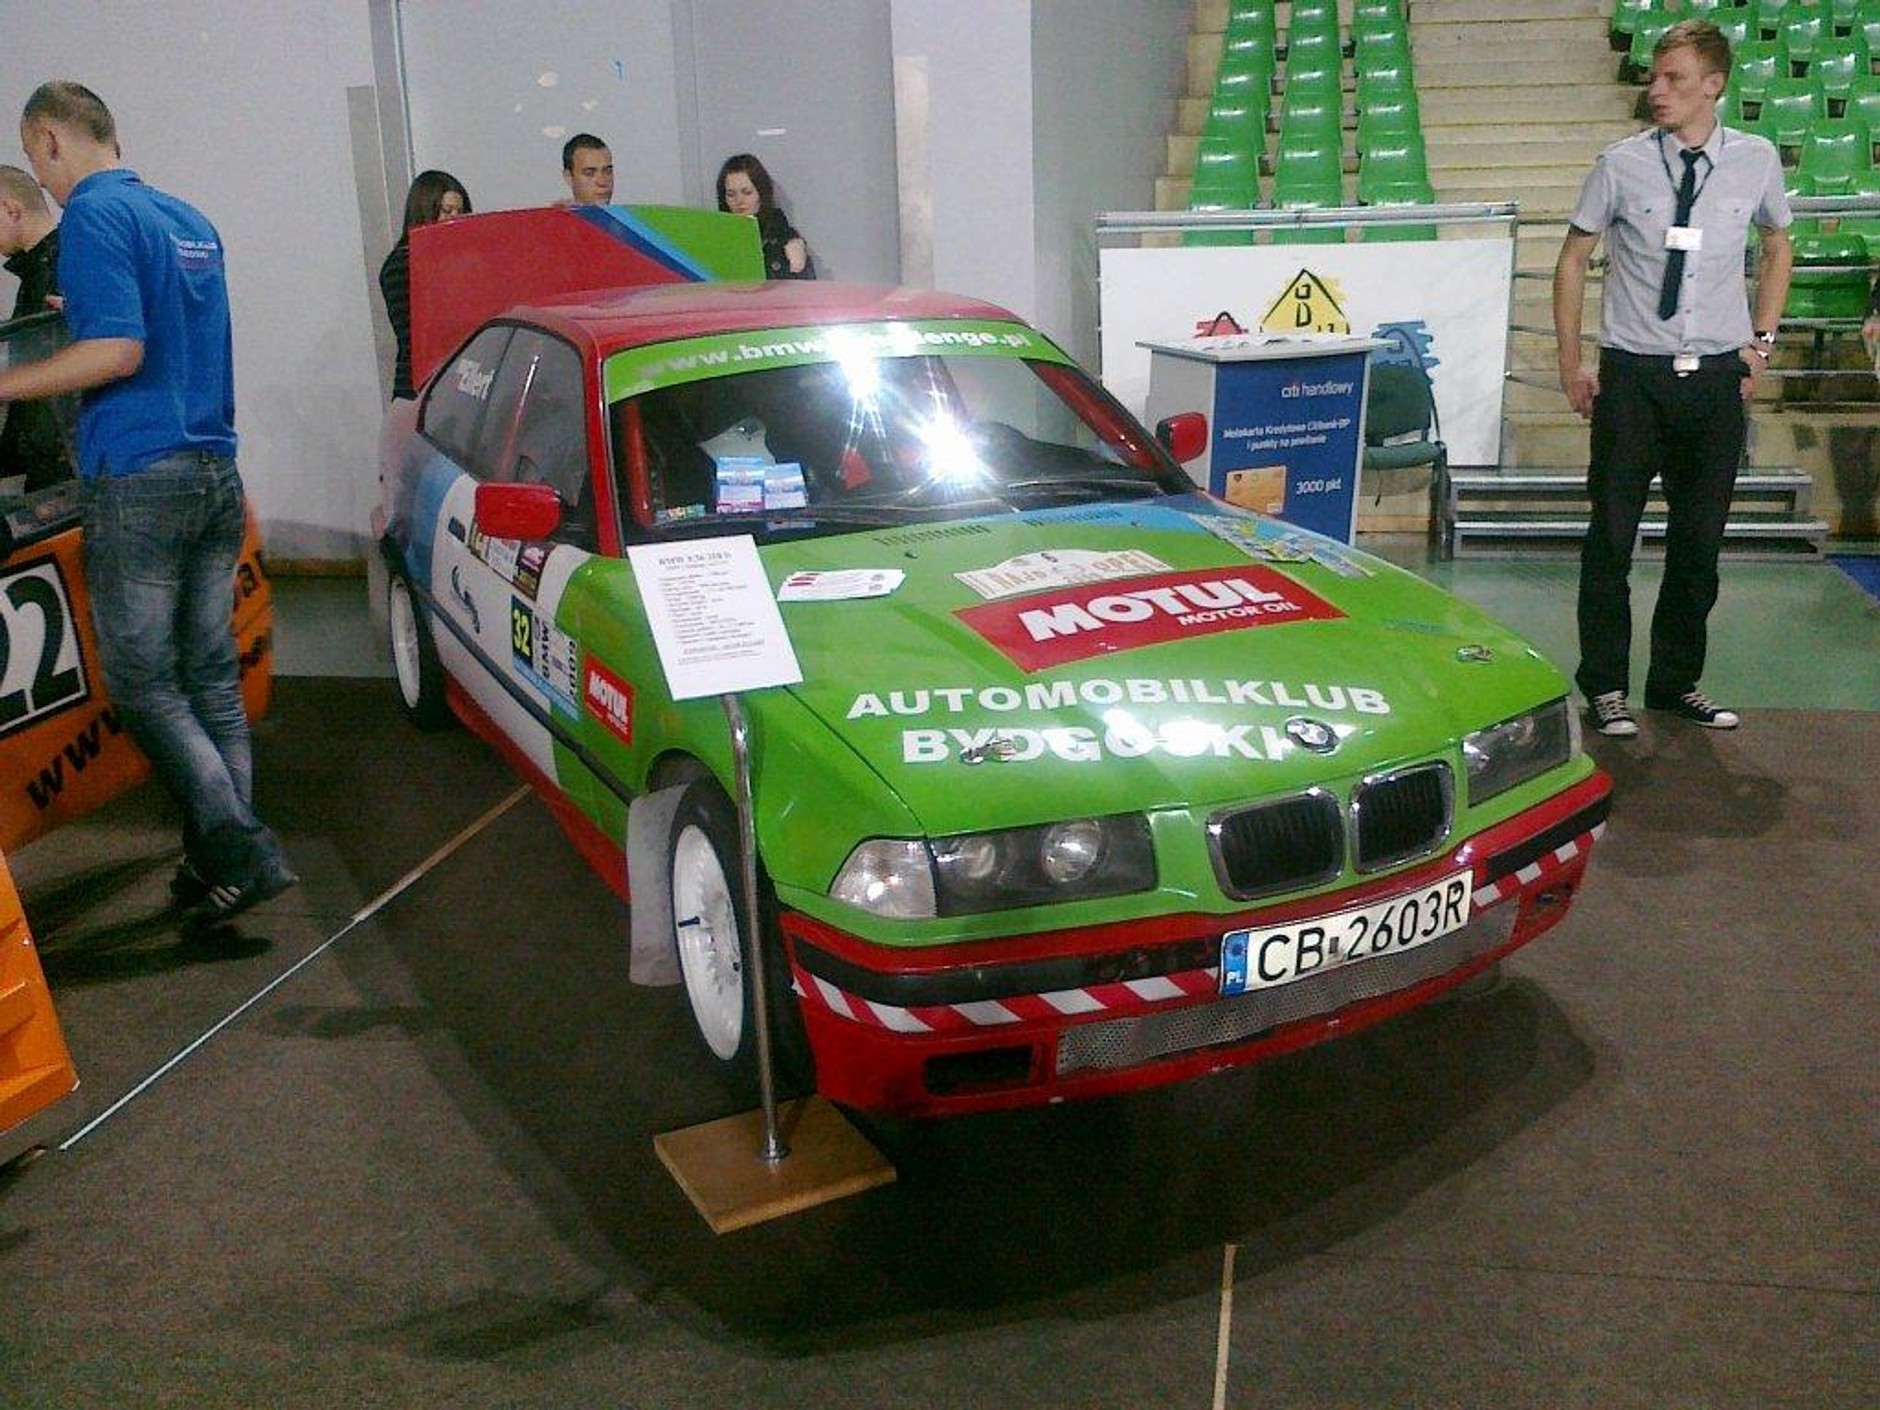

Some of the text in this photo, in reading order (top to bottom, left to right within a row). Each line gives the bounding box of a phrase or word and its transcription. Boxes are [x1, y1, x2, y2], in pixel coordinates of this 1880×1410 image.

[1301, 381, 1354, 397] handlowy
[1296, 479, 1324, 494] 3000
[1018, 578, 1285, 642] MOTUL
[1176, 600, 1303, 627] MOTOR OIL
[512, 608, 531, 657] 32
[589, 669, 629, 725] MOTUL
[846, 678, 1391, 720] AUTOMOBILKLUB
[902, 720, 1300, 762] BYDGOKI
[1257, 880, 1466, 982] CB 2603R
[1226, 971, 1244, 986] PL
